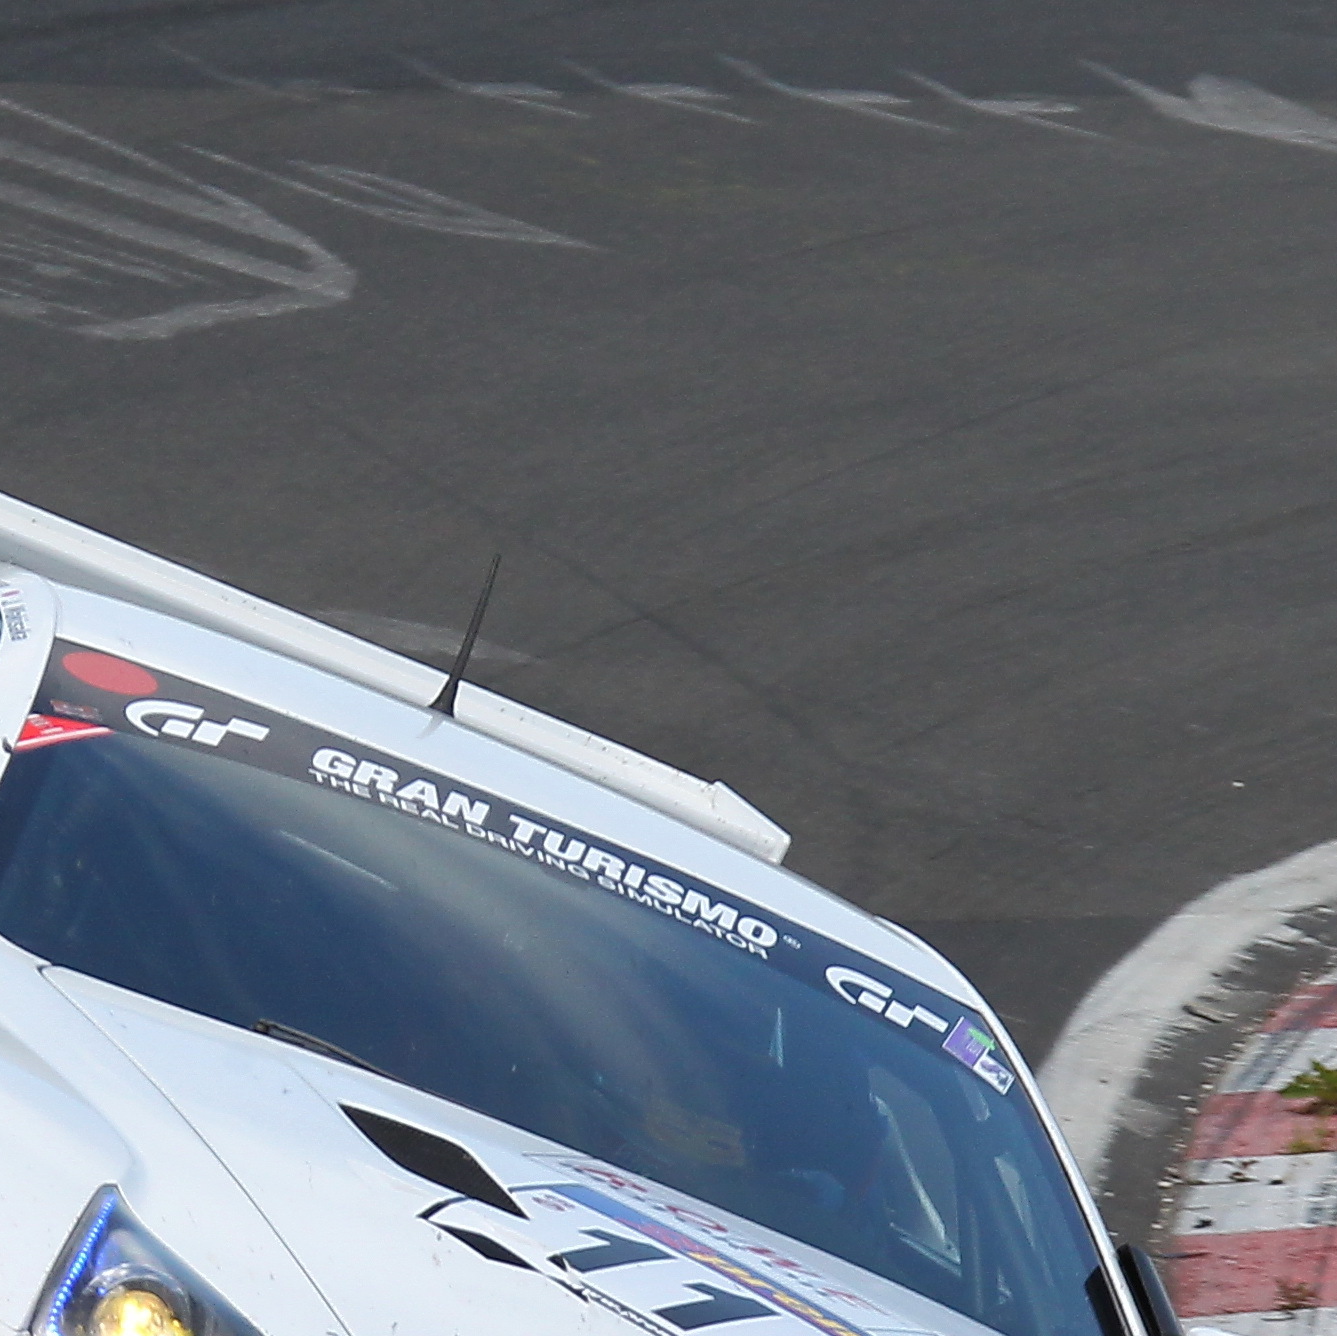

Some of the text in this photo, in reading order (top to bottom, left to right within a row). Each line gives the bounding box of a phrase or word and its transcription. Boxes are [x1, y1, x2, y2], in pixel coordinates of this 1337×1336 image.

[308, 768, 769, 961] THE REAL DRIVING SIMULATOR
[312, 747, 778, 948] GRAN TURISMO
